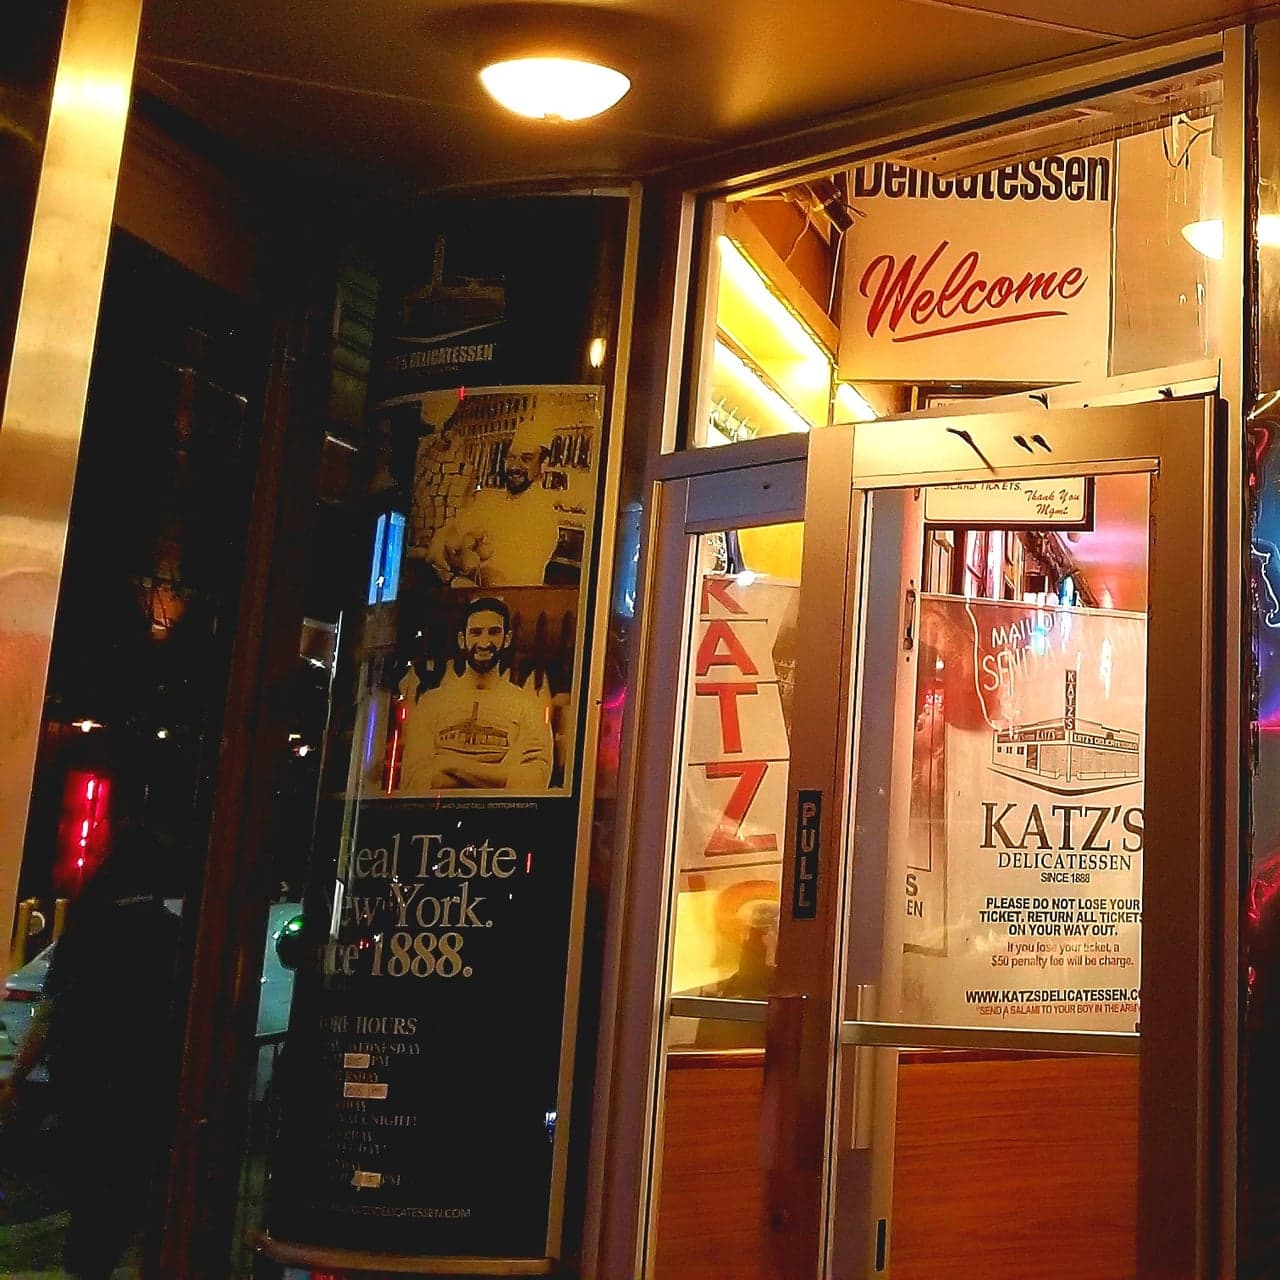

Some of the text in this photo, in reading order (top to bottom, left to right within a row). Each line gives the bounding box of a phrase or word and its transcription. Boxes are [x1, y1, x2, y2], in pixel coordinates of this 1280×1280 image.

[859, 240, 1089, 338] Welcome
[1025, 490, 1055, 502] Thank
[980, 802, 1145, 853] KATZ'S
[411, 834, 518, 879] Taste
[798, 801, 817, 908] PULL
[999, 852, 1131, 870] DELICATESSEN
[1041, 873, 1090, 884] SINCE 1888
[391, 881, 493, 928] York.
[986, 897, 1140, 910] PLEASE DO NOT LOSE YOUR
[979, 911, 1025, 923] TICKET.
[1028, 911, 1074, 923] RETURN
[1077, 912, 1097, 923] ALL
[1008, 924, 1119, 936] ON YOUR WAY OUT.
[371, 931, 474, 978] 1888.
[1016, 943, 1035, 955] you
[991, 955, 1134, 968] $50 penalty fee will be charge.
[966, 989, 1141, 1003] WWW.KATZSDELICATESSEN.C
[1042, 1005, 1052, 1014] TO
[1054, 1005, 1075, 1014] YOUR
[1077, 1005, 1093, 1014] BOY
[1104, 1004, 1118, 1013] THE
